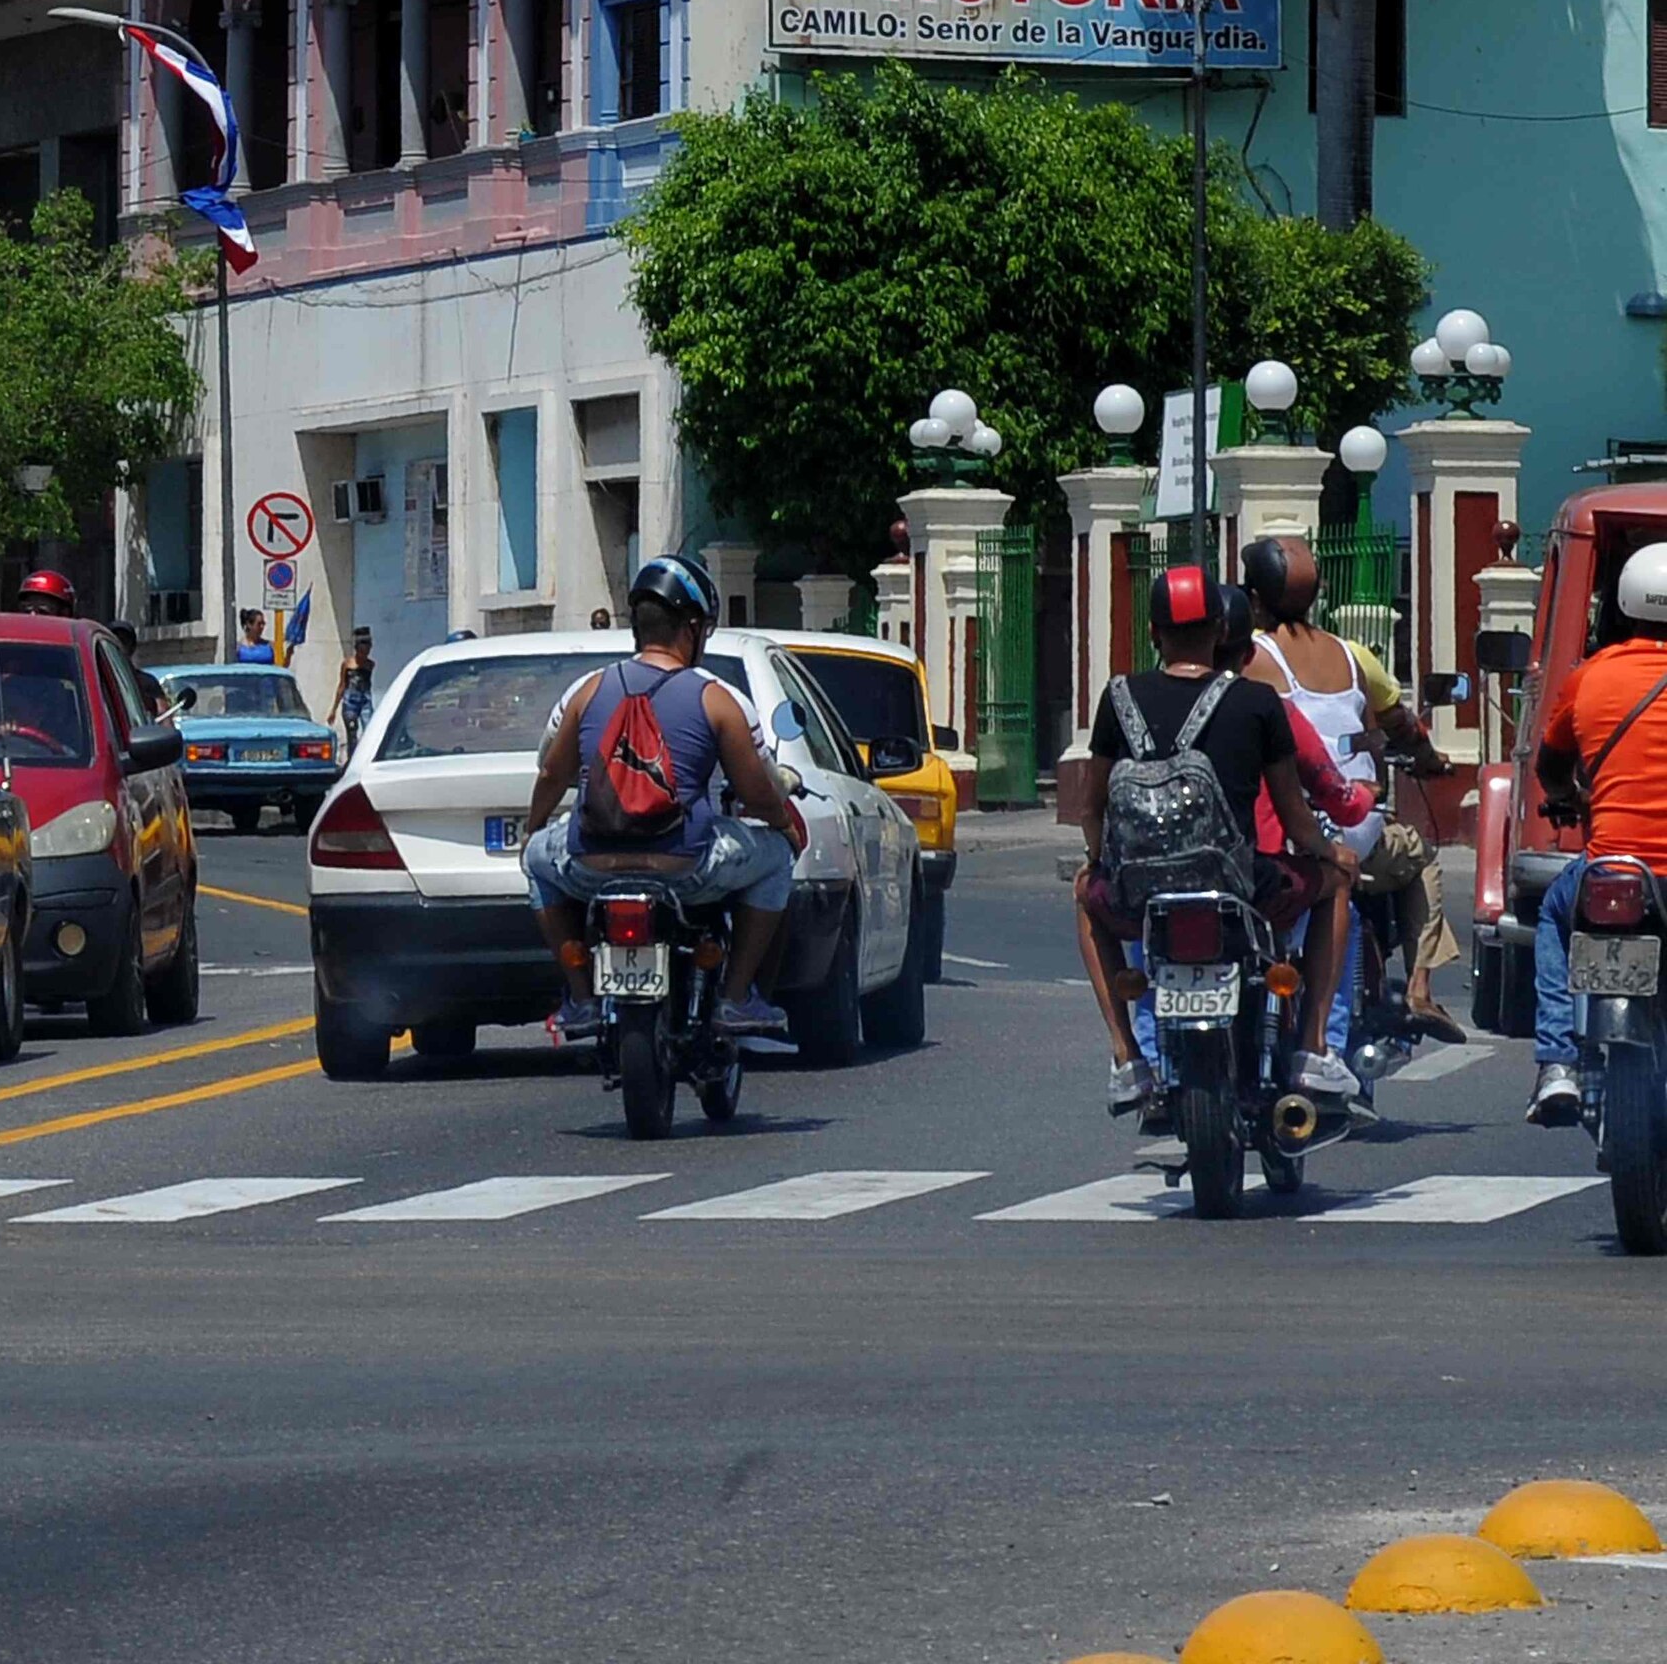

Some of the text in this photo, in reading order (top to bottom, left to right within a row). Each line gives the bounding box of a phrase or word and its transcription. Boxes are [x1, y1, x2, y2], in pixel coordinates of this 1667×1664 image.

[779, 8, 907, 38] CAMILO:
[917, 15, 1003, 43] Señor
[1011, 19, 1046, 43] de
[1056, 19, 1081, 44] la
[625, 948, 637, 968] R
[600, 970, 664, 992] 29029
[1191, 965, 1205, 987] P
[1160, 991, 1233, 1013] 30057
